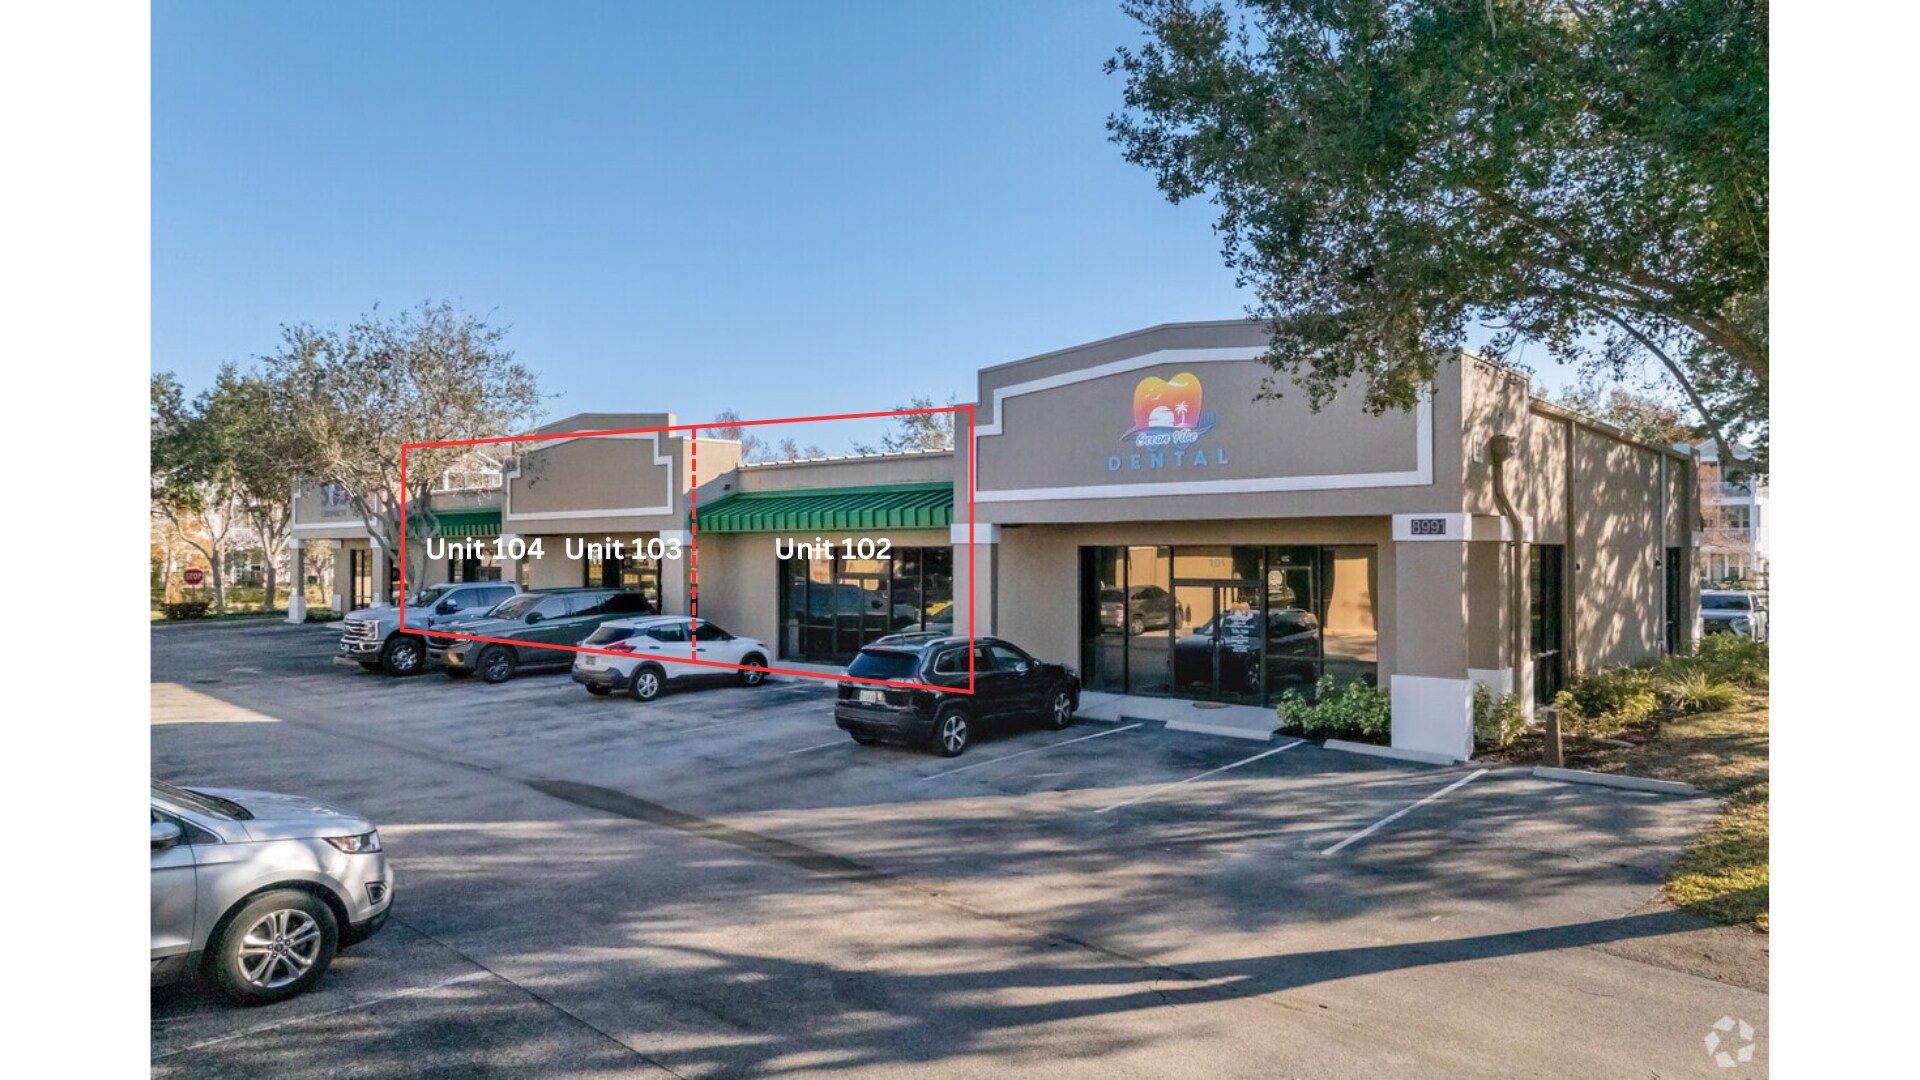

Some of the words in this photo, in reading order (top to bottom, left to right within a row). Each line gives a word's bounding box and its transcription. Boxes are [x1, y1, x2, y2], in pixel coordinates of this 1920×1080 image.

[1108, 449, 1228, 471] DENTAL
[1412, 520, 1446, 534] 8991
[185, 572, 203, 580] STOP
